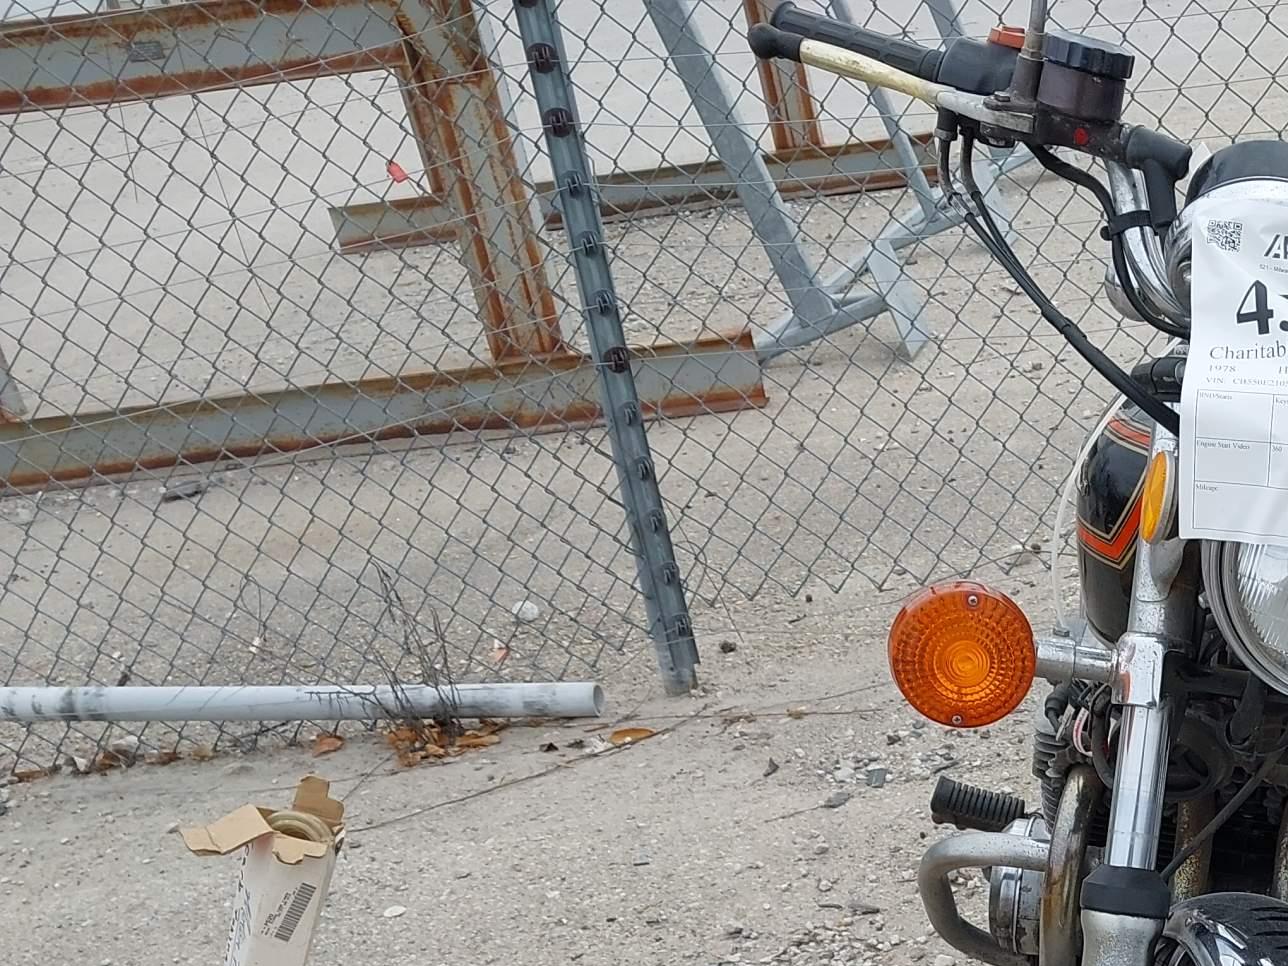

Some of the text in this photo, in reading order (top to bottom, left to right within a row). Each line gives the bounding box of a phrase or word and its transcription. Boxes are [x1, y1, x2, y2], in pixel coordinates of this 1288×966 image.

[1208, 365, 1237, 373] 1978
[1217, 441, 1231, 449] Start
[1232, 442, 1251, 450] Video
[1196, 482, 1218, 492] Mileage
